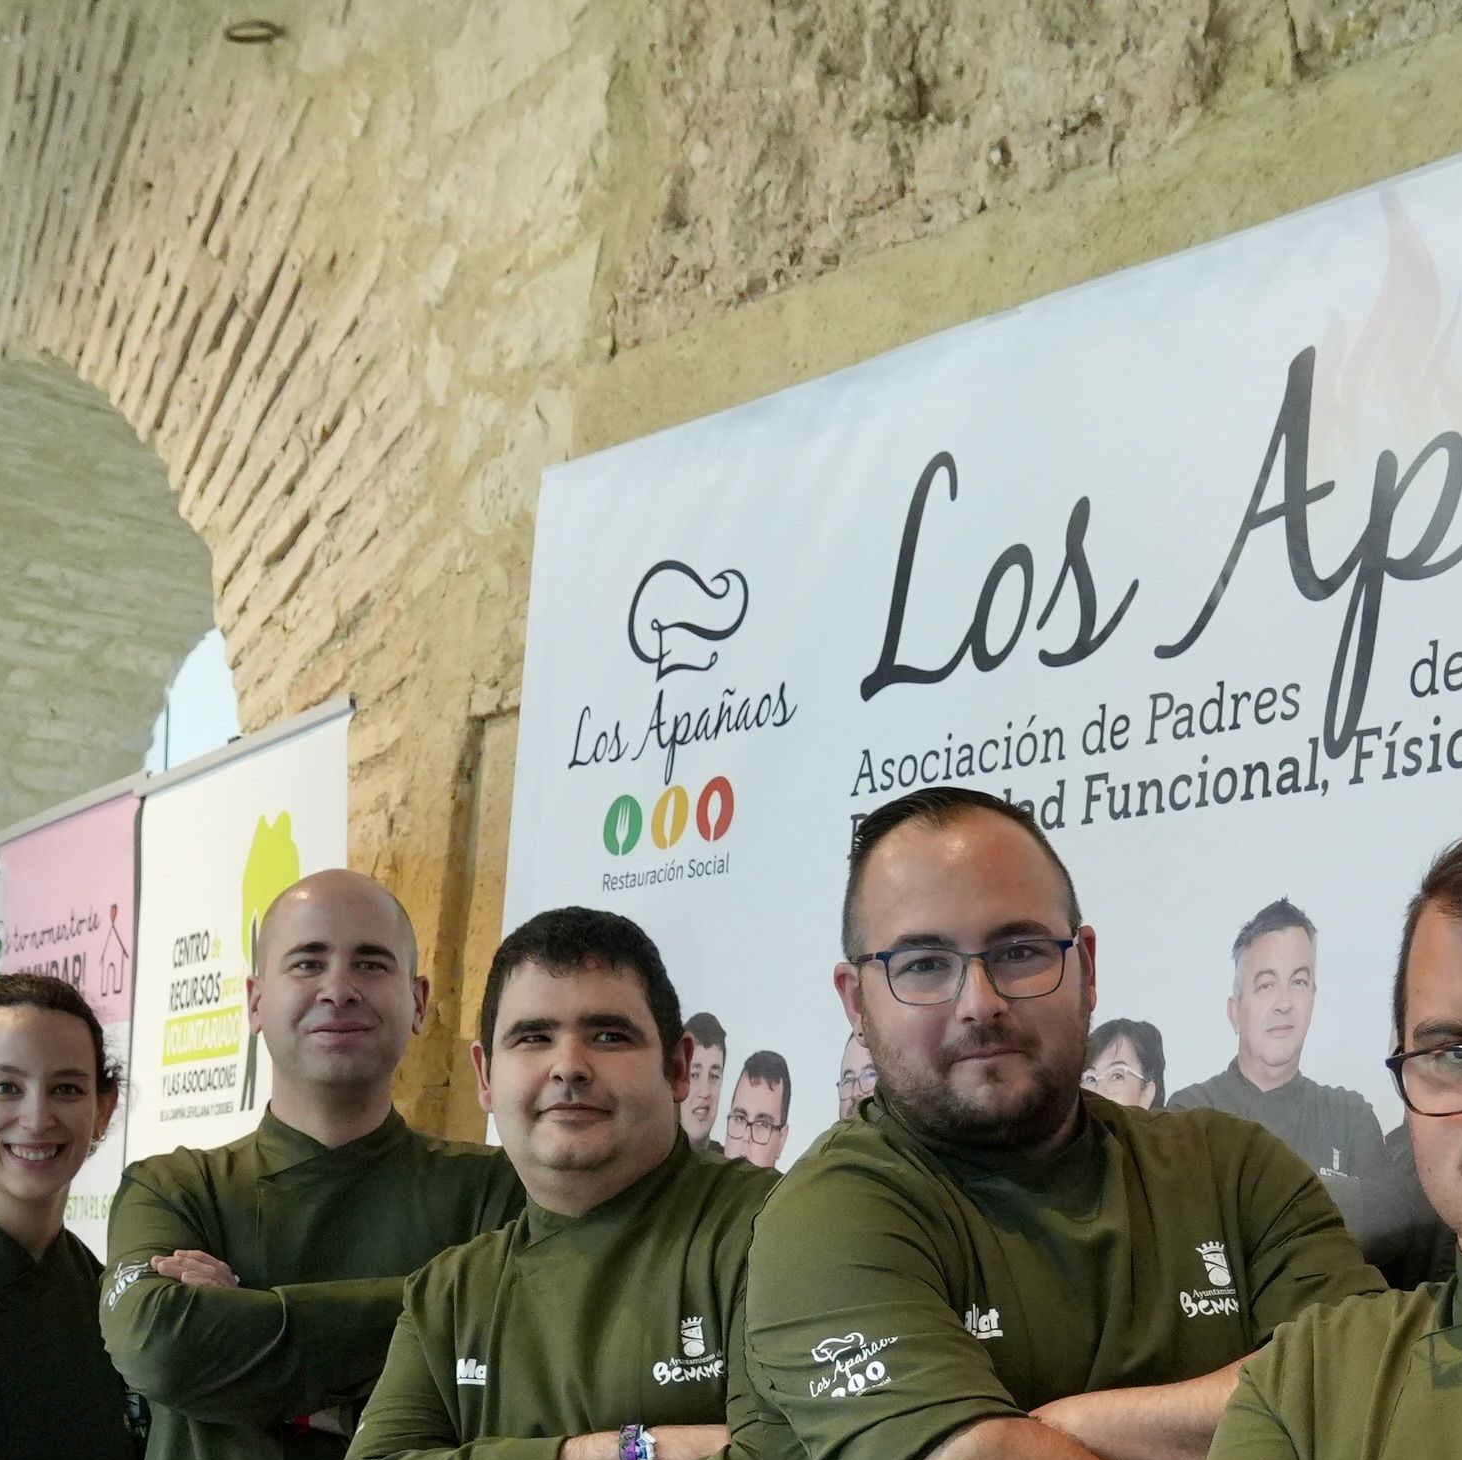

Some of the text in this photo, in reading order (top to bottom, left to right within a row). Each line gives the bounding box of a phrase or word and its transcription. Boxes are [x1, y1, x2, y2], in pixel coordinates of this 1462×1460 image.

[861, 451, 1139, 703] Los
[568, 681, 798, 786] Los Apañaos
[850, 716, 1066, 797] Asociación
[1080, 700, 1132, 754] de
[1143, 678, 1302, 747] Padres
[1080, 737, 1331, 828] Funcional,
[602, 852, 729, 892] Restauración Social
[169, 971, 222, 1012] RECURSOS
[173, 930, 211, 968] CENTRO
